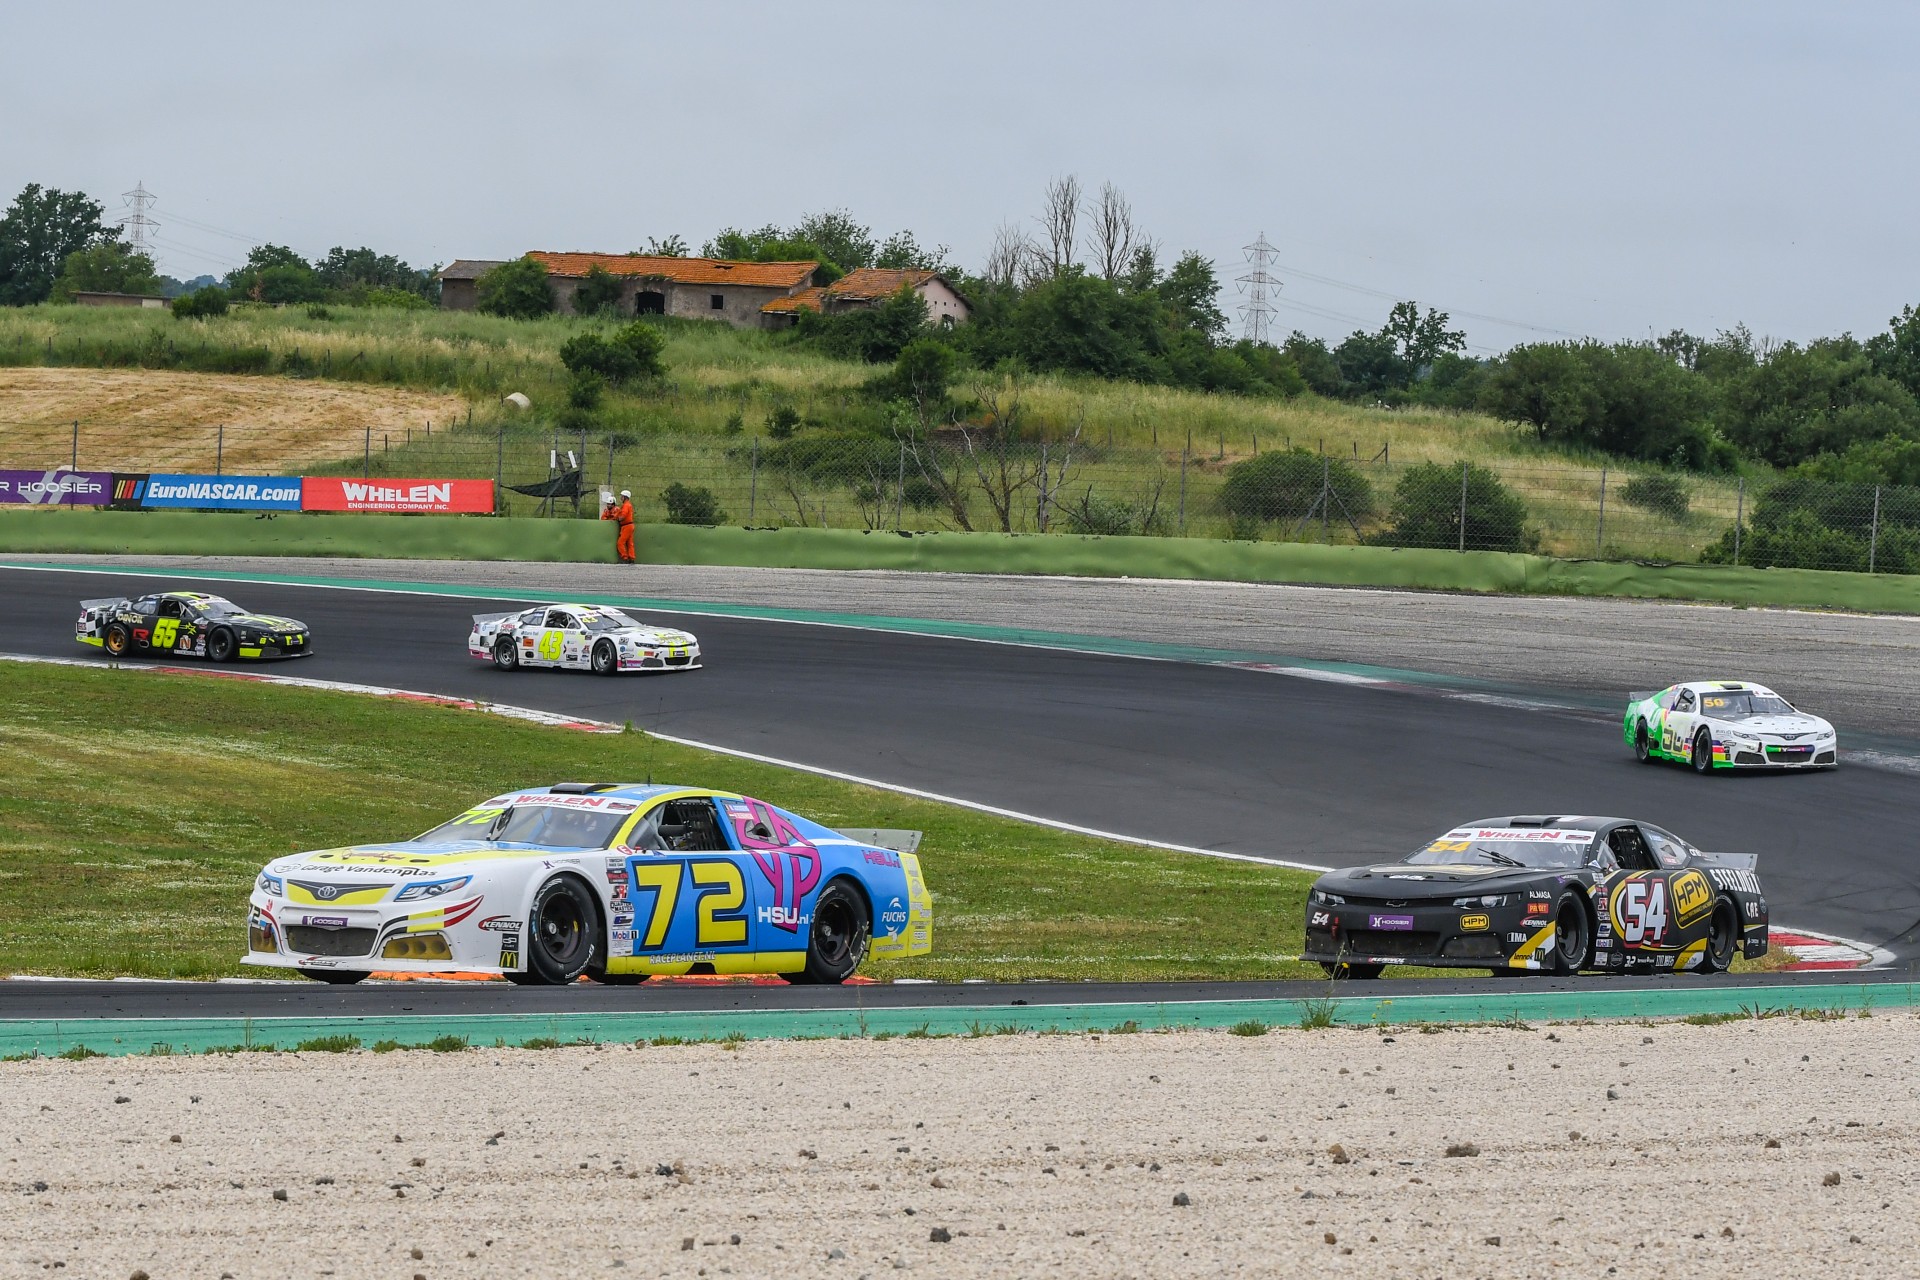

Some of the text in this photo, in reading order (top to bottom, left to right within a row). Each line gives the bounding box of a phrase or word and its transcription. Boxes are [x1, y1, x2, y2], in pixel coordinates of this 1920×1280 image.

[17, 481, 102, 497] HOOSIER
[148, 482, 300, 503] EuroNASCAR.com
[341, 481, 452, 503] WHELEN
[347, 502, 396, 510] ENGINEERING
[433, 503, 450, 511] INC.
[152, 617, 181, 648] 55
[538, 630, 564, 661] 43
[516, 795, 607, 807] WHELEN
[1478, 830, 1562, 840] WHELEN
[1427, 841, 1472, 853] 54
[301, 865, 440, 877] Garage Vandenplas
[1675, 874, 1708, 910] HPM
[631, 857, 749, 952] 72
[757, 907, 809, 925] HSU.nl
[881, 910, 907, 923] FUCHS
[1311, 911, 1330, 926] 54
[1624, 878, 1669, 949] 54
[313, 918, 344, 927] HOOSIER
[482, 921, 522, 930] KENNOL
[1461, 918, 1487, 928] HPM
[612, 930, 631, 940] Mobil
[650, 950, 717, 965] RACEPLANET.NL
